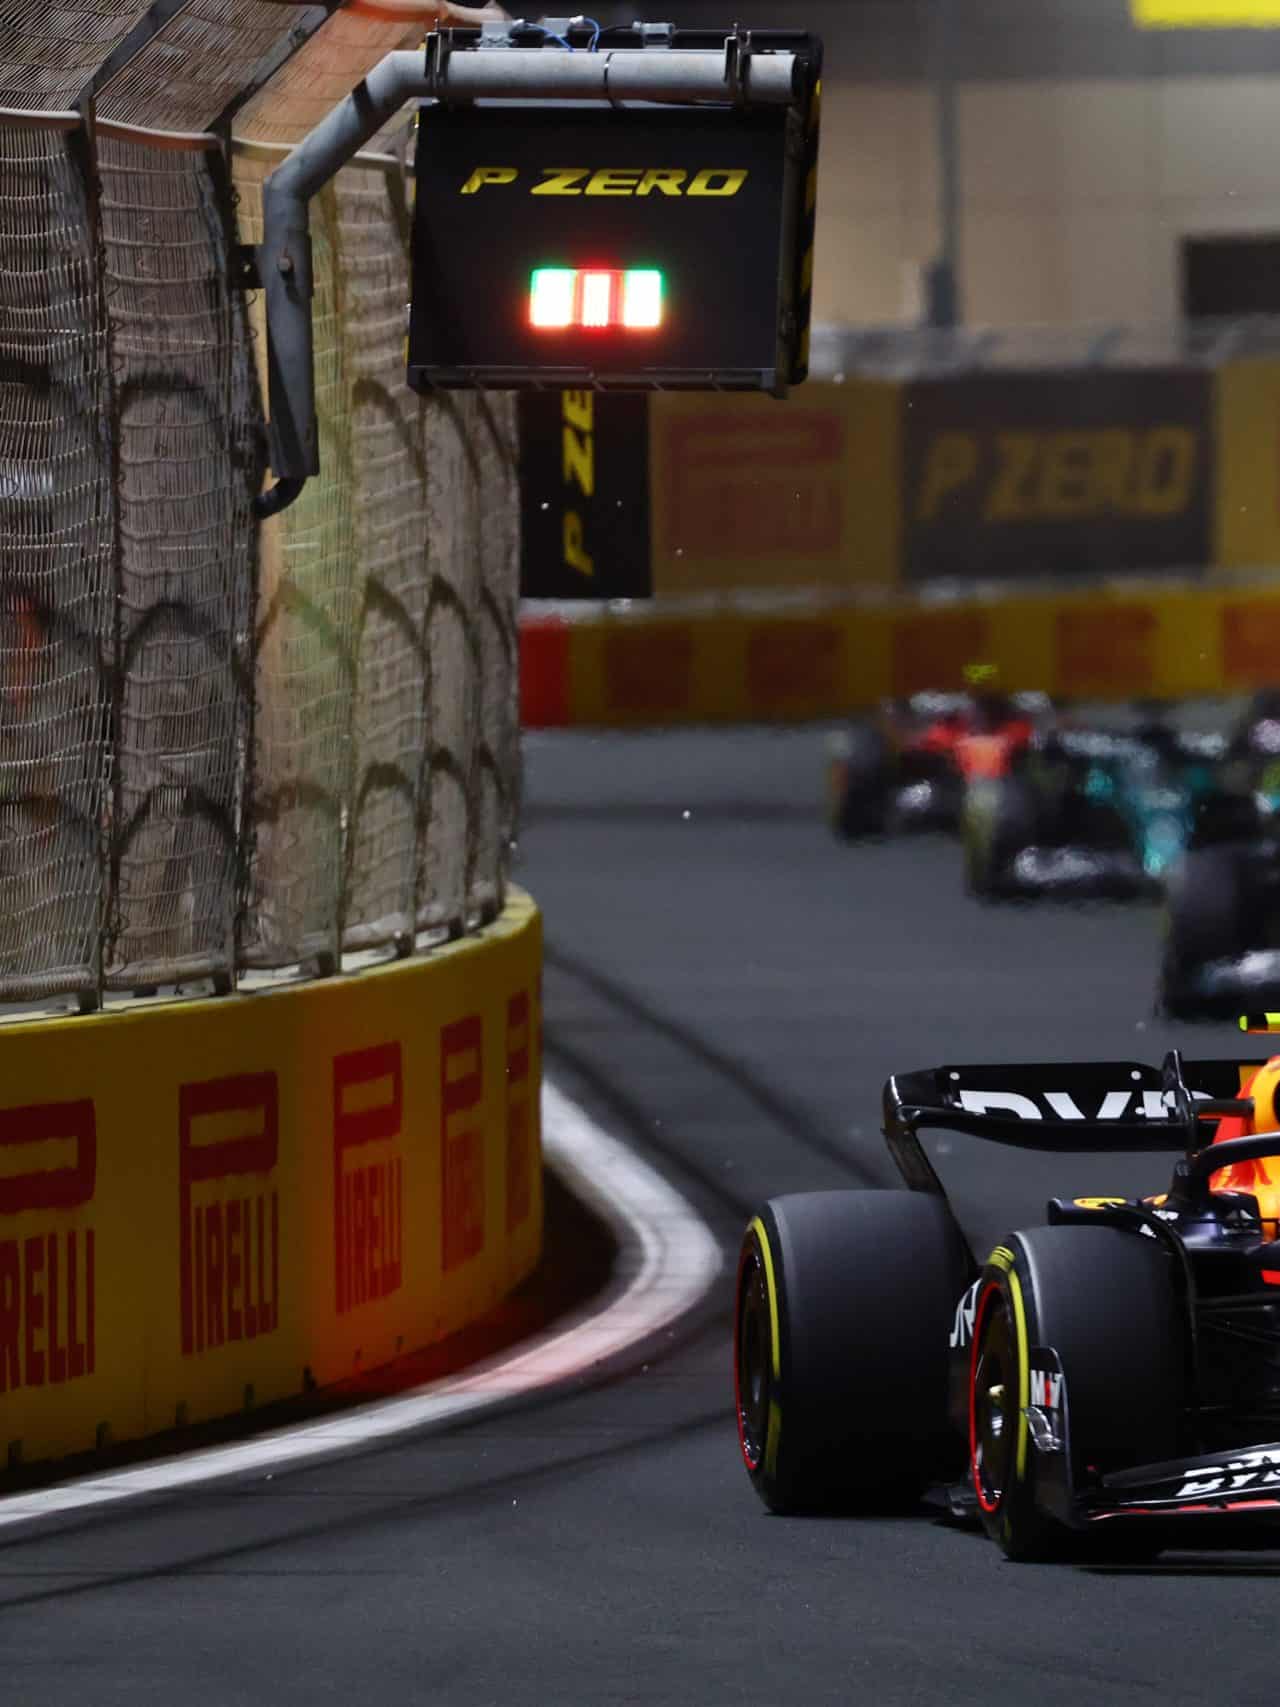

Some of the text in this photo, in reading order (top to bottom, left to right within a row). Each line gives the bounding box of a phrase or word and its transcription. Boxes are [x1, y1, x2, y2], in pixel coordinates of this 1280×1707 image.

[460, 167, 749, 196] P ZERO
[179, 1070, 279, 1357] PIRELLI
